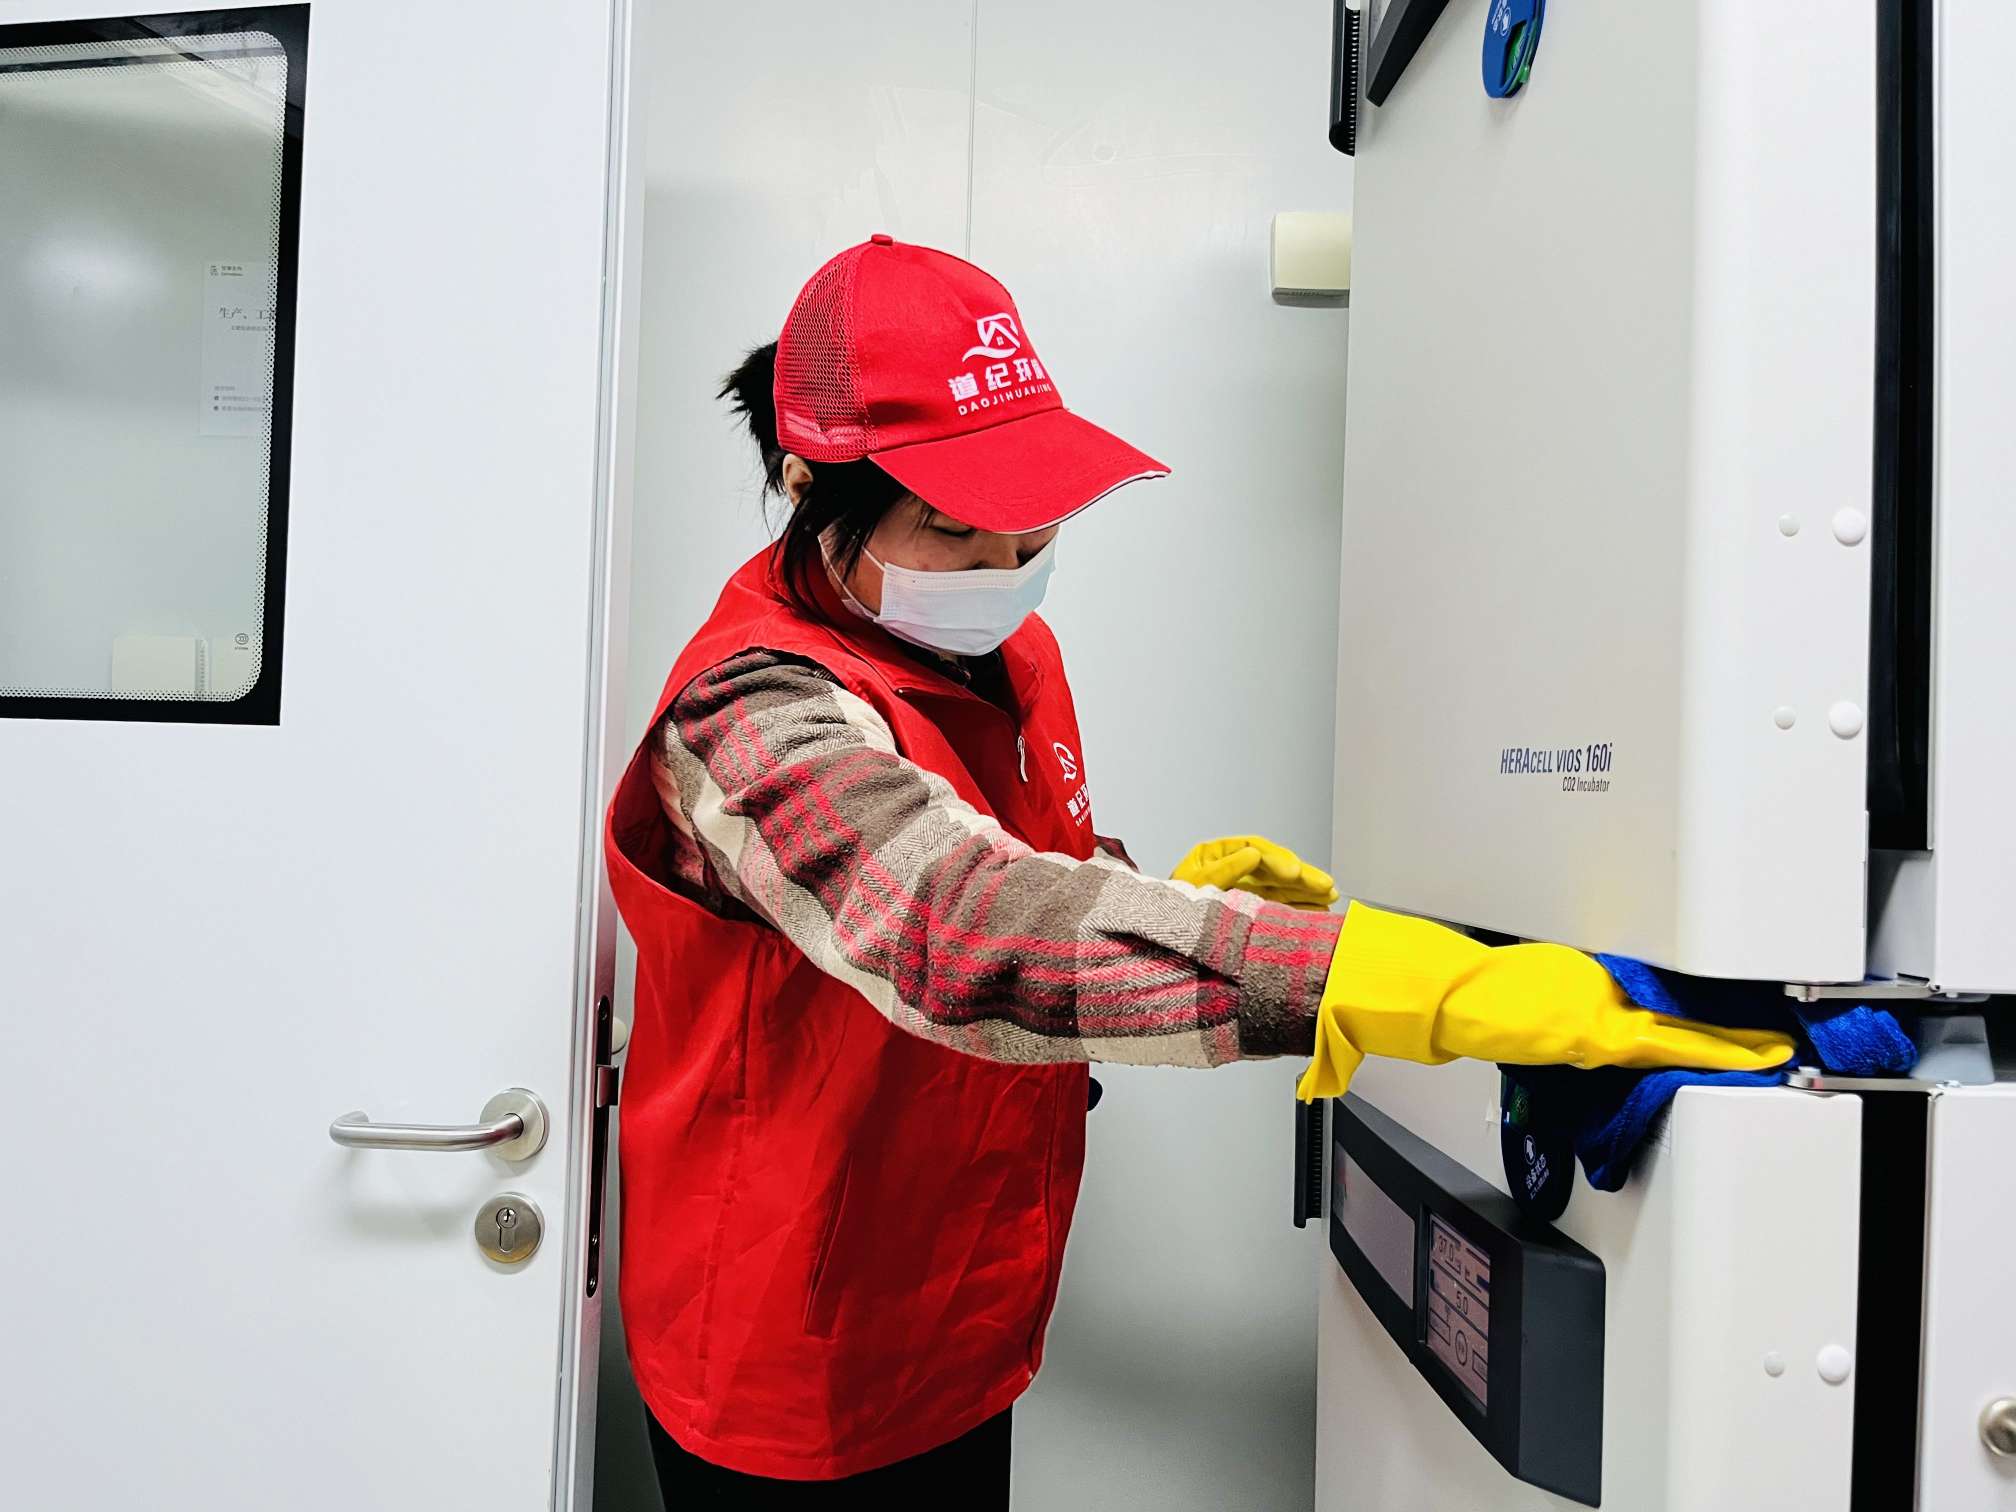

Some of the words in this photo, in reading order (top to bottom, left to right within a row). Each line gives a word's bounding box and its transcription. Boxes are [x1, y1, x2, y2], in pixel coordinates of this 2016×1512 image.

[1556, 748, 1582, 773] VIOS
[1586, 742, 1613, 772] 160i
[1562, 776, 1576, 792] CO2
[1577, 777, 1610, 792] Incubator
